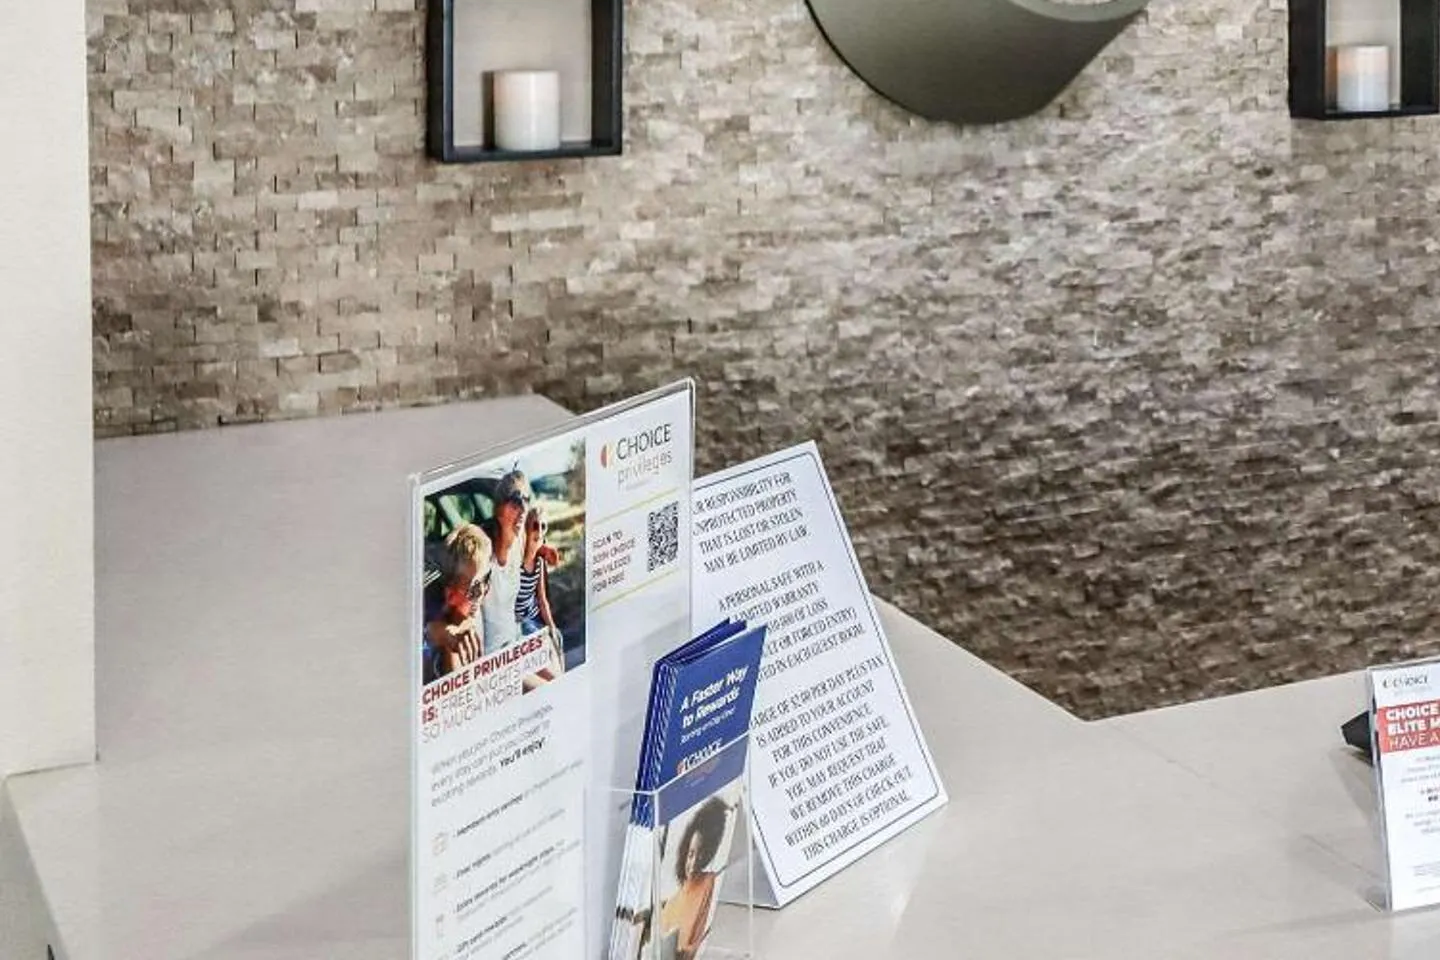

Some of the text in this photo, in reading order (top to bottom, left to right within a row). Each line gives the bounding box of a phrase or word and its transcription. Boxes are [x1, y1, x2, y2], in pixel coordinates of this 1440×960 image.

[616, 424, 672, 460] CHOICE
[618, 451, 673, 488] privileges
[704, 478, 773, 510] RESPONSIBILITY
[773, 472, 791, 486] FOR
[754, 489, 797, 513] PROPERTY
[609, 538, 636, 559] CHOICE
[699, 507, 803, 553] THAT IS LOST OR STOLEN
[592, 554, 631, 578] PRIVILEGES
[704, 556, 725, 573] MAY
[725, 551, 738, 565] BE
[738, 537, 776, 560] LIMITED
[776, 532, 788, 546] BY
[716, 559, 824, 611] A PERSONAL SAFE WITH A
[771, 581, 819, 609] WARRANTY
[804, 598, 828, 616] LOSS
[785, 647, 809, 667] EACH
[809, 634, 838, 656] GUEST
[791, 619, 827, 644] FORCED
[422, 635, 542, 705] CHOICE PRIVILEGES
[422, 649, 548, 724] IS: FREE NIGHTS AND
[680, 665, 749, 713] A Faster Way
[750, 705, 775, 727] ARGE
[775, 698, 789, 715] OF
[810, 681, 827, 699] PER
[826, 673, 844, 691] DAY
[845, 663, 865, 682] PLUS
[864, 654, 884, 673] TAX
[421, 684, 520, 743] SO MUCH MORE
[683, 687, 740, 728] to Rewards
[755, 680, 875, 747] IS ADDED TO YOUR ACCOUNT
[1386, 704, 1439, 720] CHOICE
[1388, 720, 1426, 735] ELITE
[771, 703, 873, 762] FOR THIS CONVENIENCE
[1390, 734, 1426, 751] HAVE
[1429, 731, 1440, 743] A
[767, 771, 779, 787] IF
[778, 761, 798, 782] YOU
[798, 753, 814, 771] DO
[813, 744, 832, 763] NOT
[831, 735, 850, 755] USE
[849, 727, 866, 745] THE
[785, 737, 887, 800] YOU MAY REQUEST THAT
[789, 753, 896, 821] WE REMOVE THIS CHARGE
[784, 818, 819, 847] WITHIN
[828, 799, 853, 822] DAYS
[852, 792, 865, 809] OF
[864, 777, 894, 802] CHECK
[801, 838, 824, 861] THIS
[822, 817, 860, 849] CHARGE
[858, 812, 870, 828] IS
